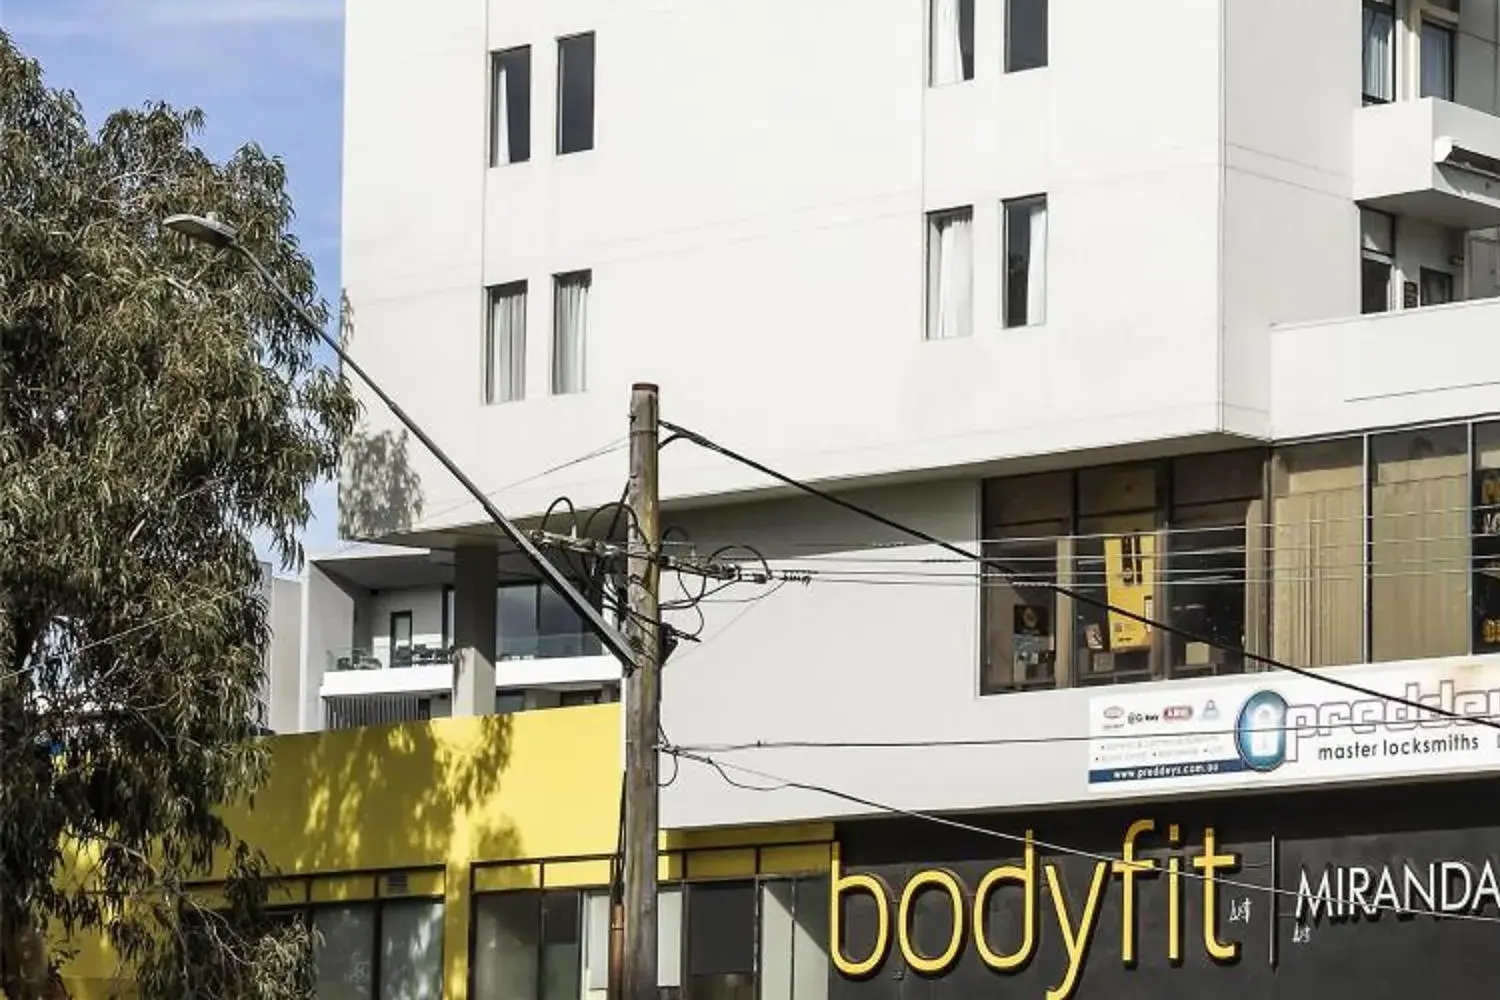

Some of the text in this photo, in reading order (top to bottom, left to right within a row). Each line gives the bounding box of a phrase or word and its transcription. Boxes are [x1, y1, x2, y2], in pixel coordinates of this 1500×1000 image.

[1318, 734, 1479, 761] master locksmiths
[1113, 763, 1219, 779] www.preddeys.com.au
[830, 819, 1236, 1000] bodyfit
